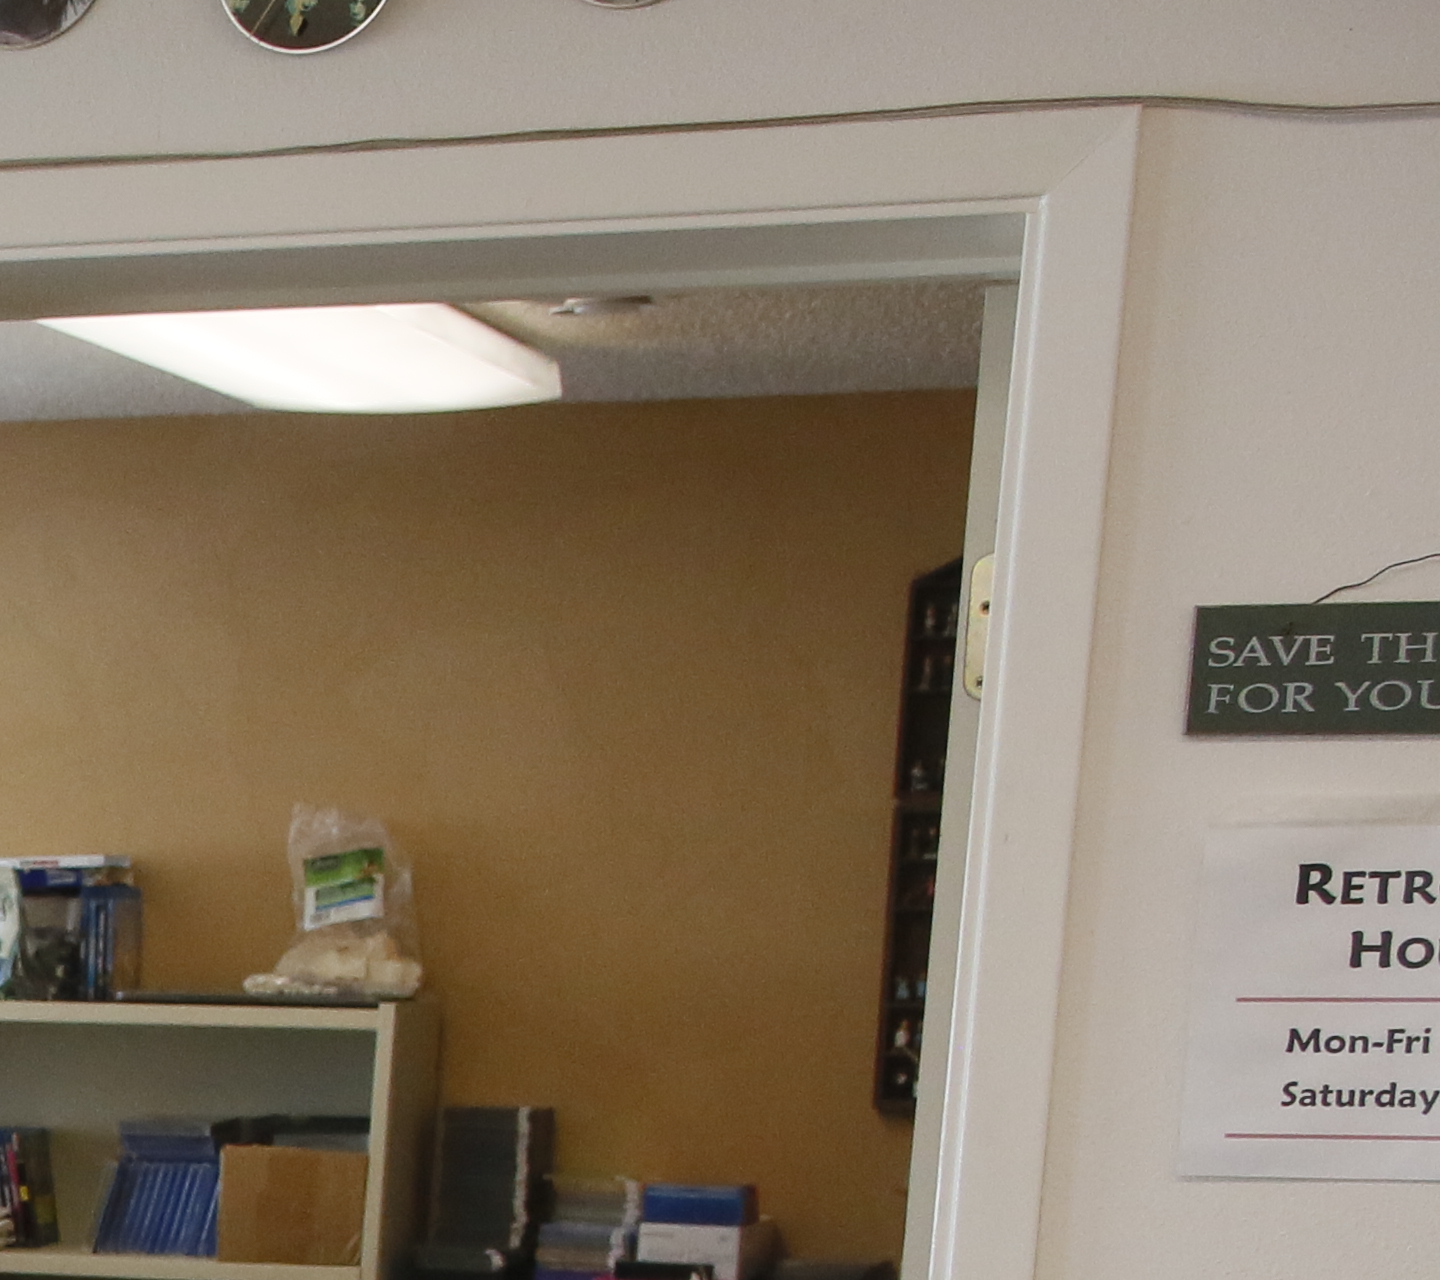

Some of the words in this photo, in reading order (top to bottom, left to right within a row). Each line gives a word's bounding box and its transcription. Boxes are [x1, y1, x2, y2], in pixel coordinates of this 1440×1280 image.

[1207, 635, 1336, 667] SAVE
[1360, 631, 1440, 664] TH
[1205, 681, 1315, 713] FOR
[1295, 863, 1440, 905] RETR
[1349, 930, 1440, 969] HO
[1285, 1027, 1432, 1055] Mon-Fri
[1280, 1080, 1440, 1115] Saturday
